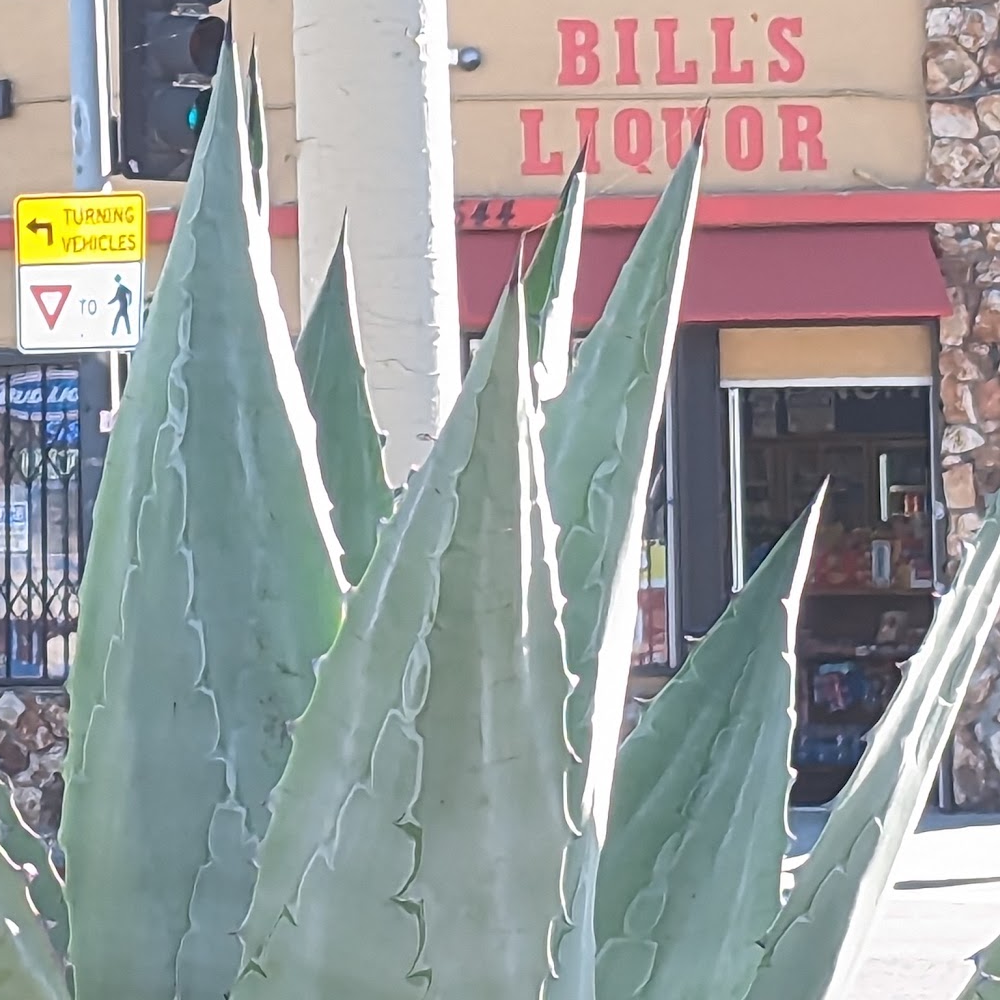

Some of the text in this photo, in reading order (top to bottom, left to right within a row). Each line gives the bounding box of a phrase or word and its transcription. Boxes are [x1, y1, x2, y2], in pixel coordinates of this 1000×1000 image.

[520, 104, 828, 175] LIQUOR
[63, 206, 135, 226] TURNING
[61, 234, 136, 253] VEHICLES
[79, 299, 98, 316] TO
